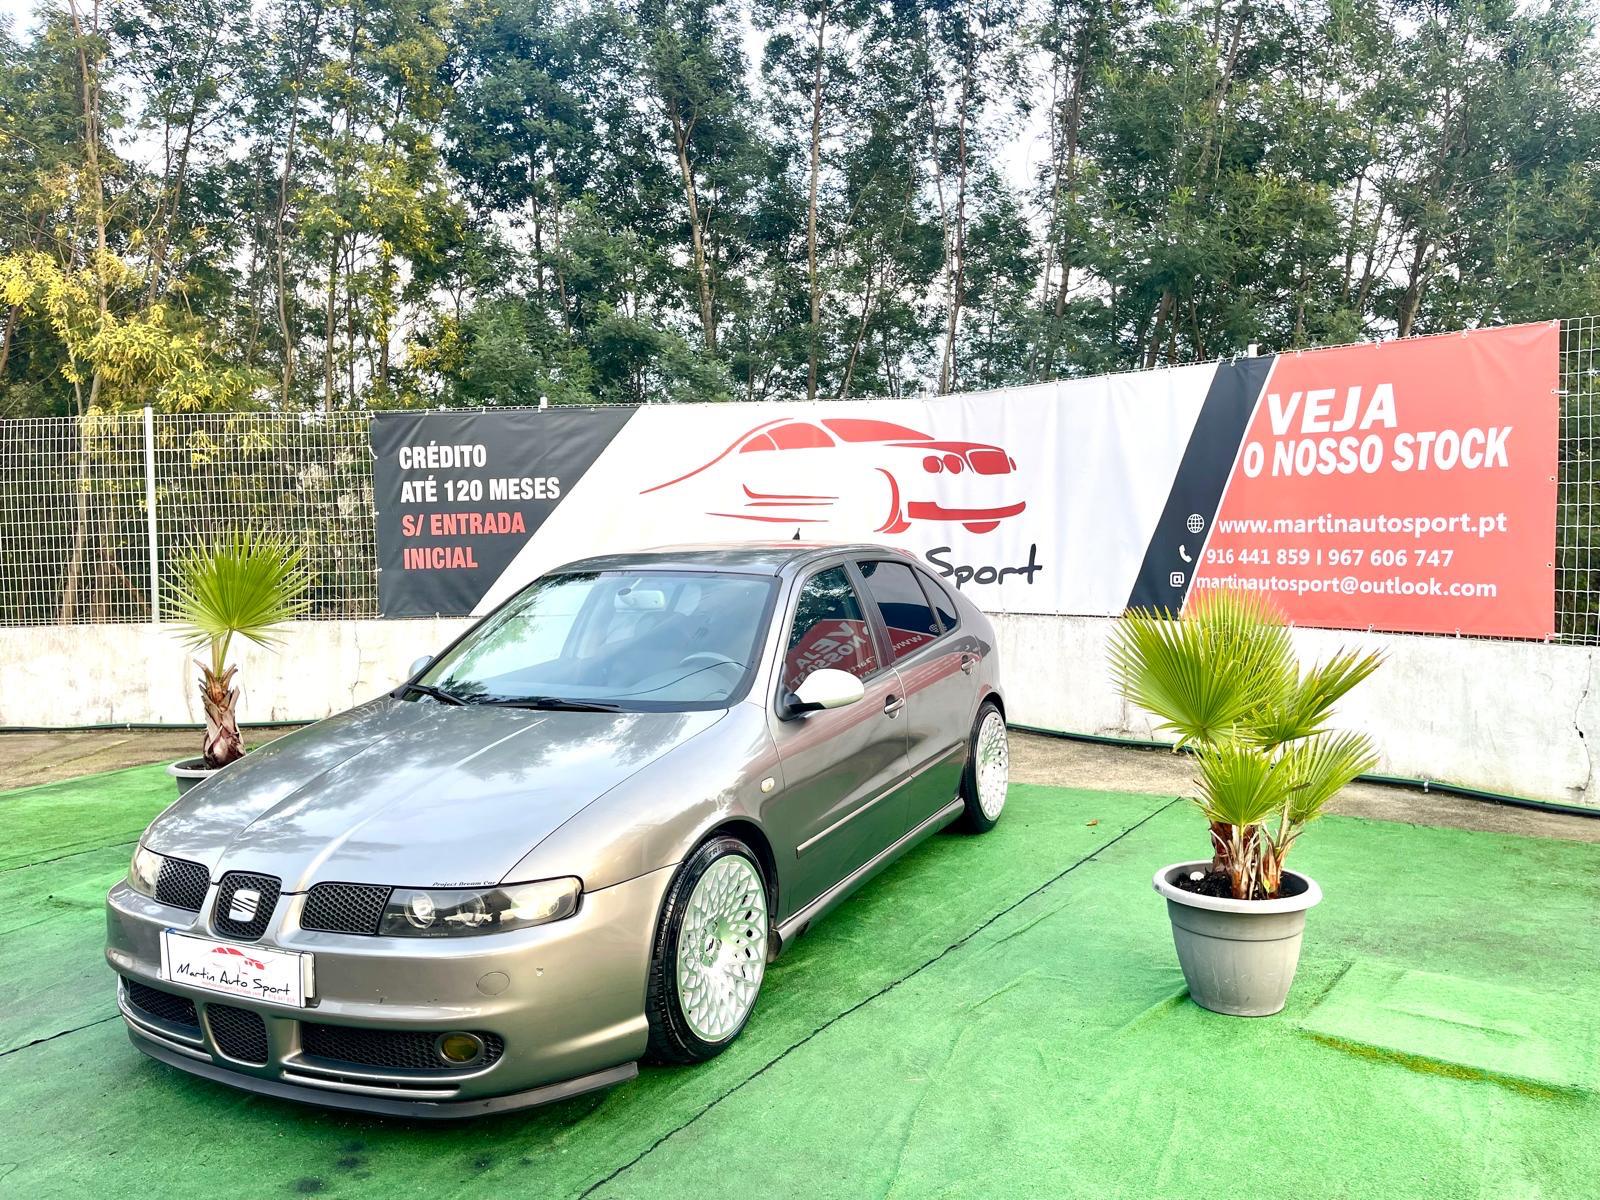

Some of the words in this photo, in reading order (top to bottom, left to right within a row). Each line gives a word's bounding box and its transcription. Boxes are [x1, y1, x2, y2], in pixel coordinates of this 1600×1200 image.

[1267, 383, 1398, 436] VEJA
[399, 441, 487, 470] CRÉDITO
[1243, 441, 1265, 478] O
[1271, 434, 1384, 477] NOSSO
[1391, 426, 1513, 472] STOCK
[400, 475, 438, 504] ATÉ
[444, 479, 483, 502] 120
[489, 477, 561, 501] MESES
[402, 514, 423, 537] S/
[430, 511, 526, 536] ENTRADA
[1218, 513, 1508, 539] www.martinautosport.pt
[403, 547, 478, 570] INICIAL
[925, 543, 1042, 590] Sport
[1206, 549, 1235, 565] 916
[1238, 548, 1271, 565] 441
[1276, 549, 1310, 566] 859
[1328, 549, 1364, 567] 967
[1370, 549, 1408, 567] 606
[1414, 549, 1454, 567] 747
[1196, 573, 1497, 598] martinautosport@outlook.com
[176, 963, 215, 982] Martin
[219, 970, 248, 988] Auto
[253, 978, 291, 997] Sport
